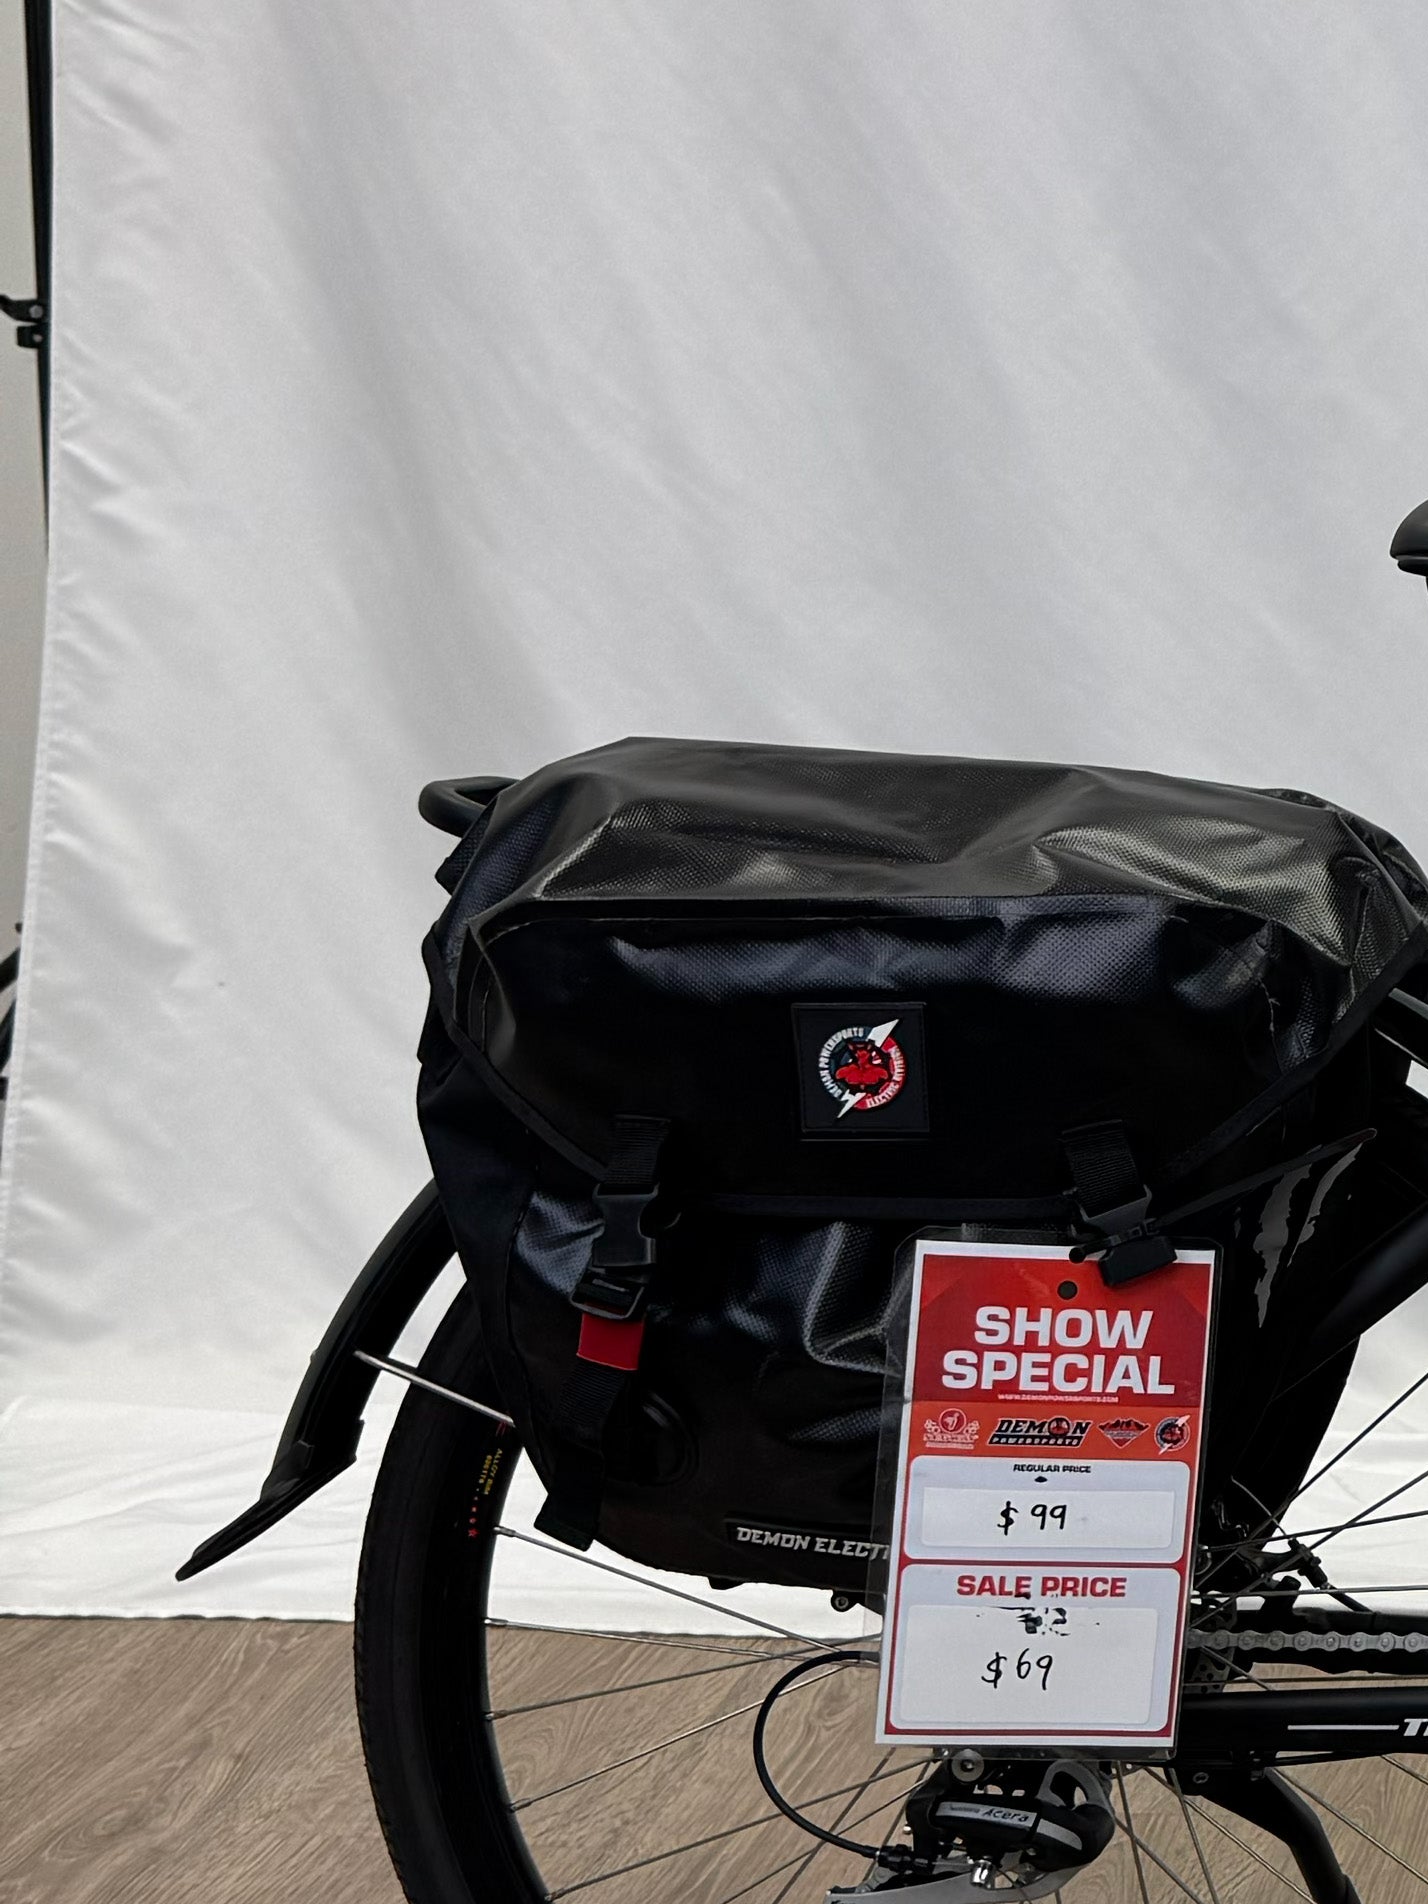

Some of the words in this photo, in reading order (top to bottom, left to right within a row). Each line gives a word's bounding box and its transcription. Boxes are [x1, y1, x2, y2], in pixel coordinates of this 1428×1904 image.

[973, 1305, 1154, 1349] SHOW
[941, 1349, 1176, 1394] SPECIAL
[1012, 1463, 1060, 1473] REGULAR
[1062, 1464, 1092, 1474] PRICE
[736, 1526, 811, 1551] DEMON
[956, 1574, 1032, 1597] SALE
[1040, 1575, 1128, 1598] PRICE
[982, 1806, 1030, 1824] Acera
